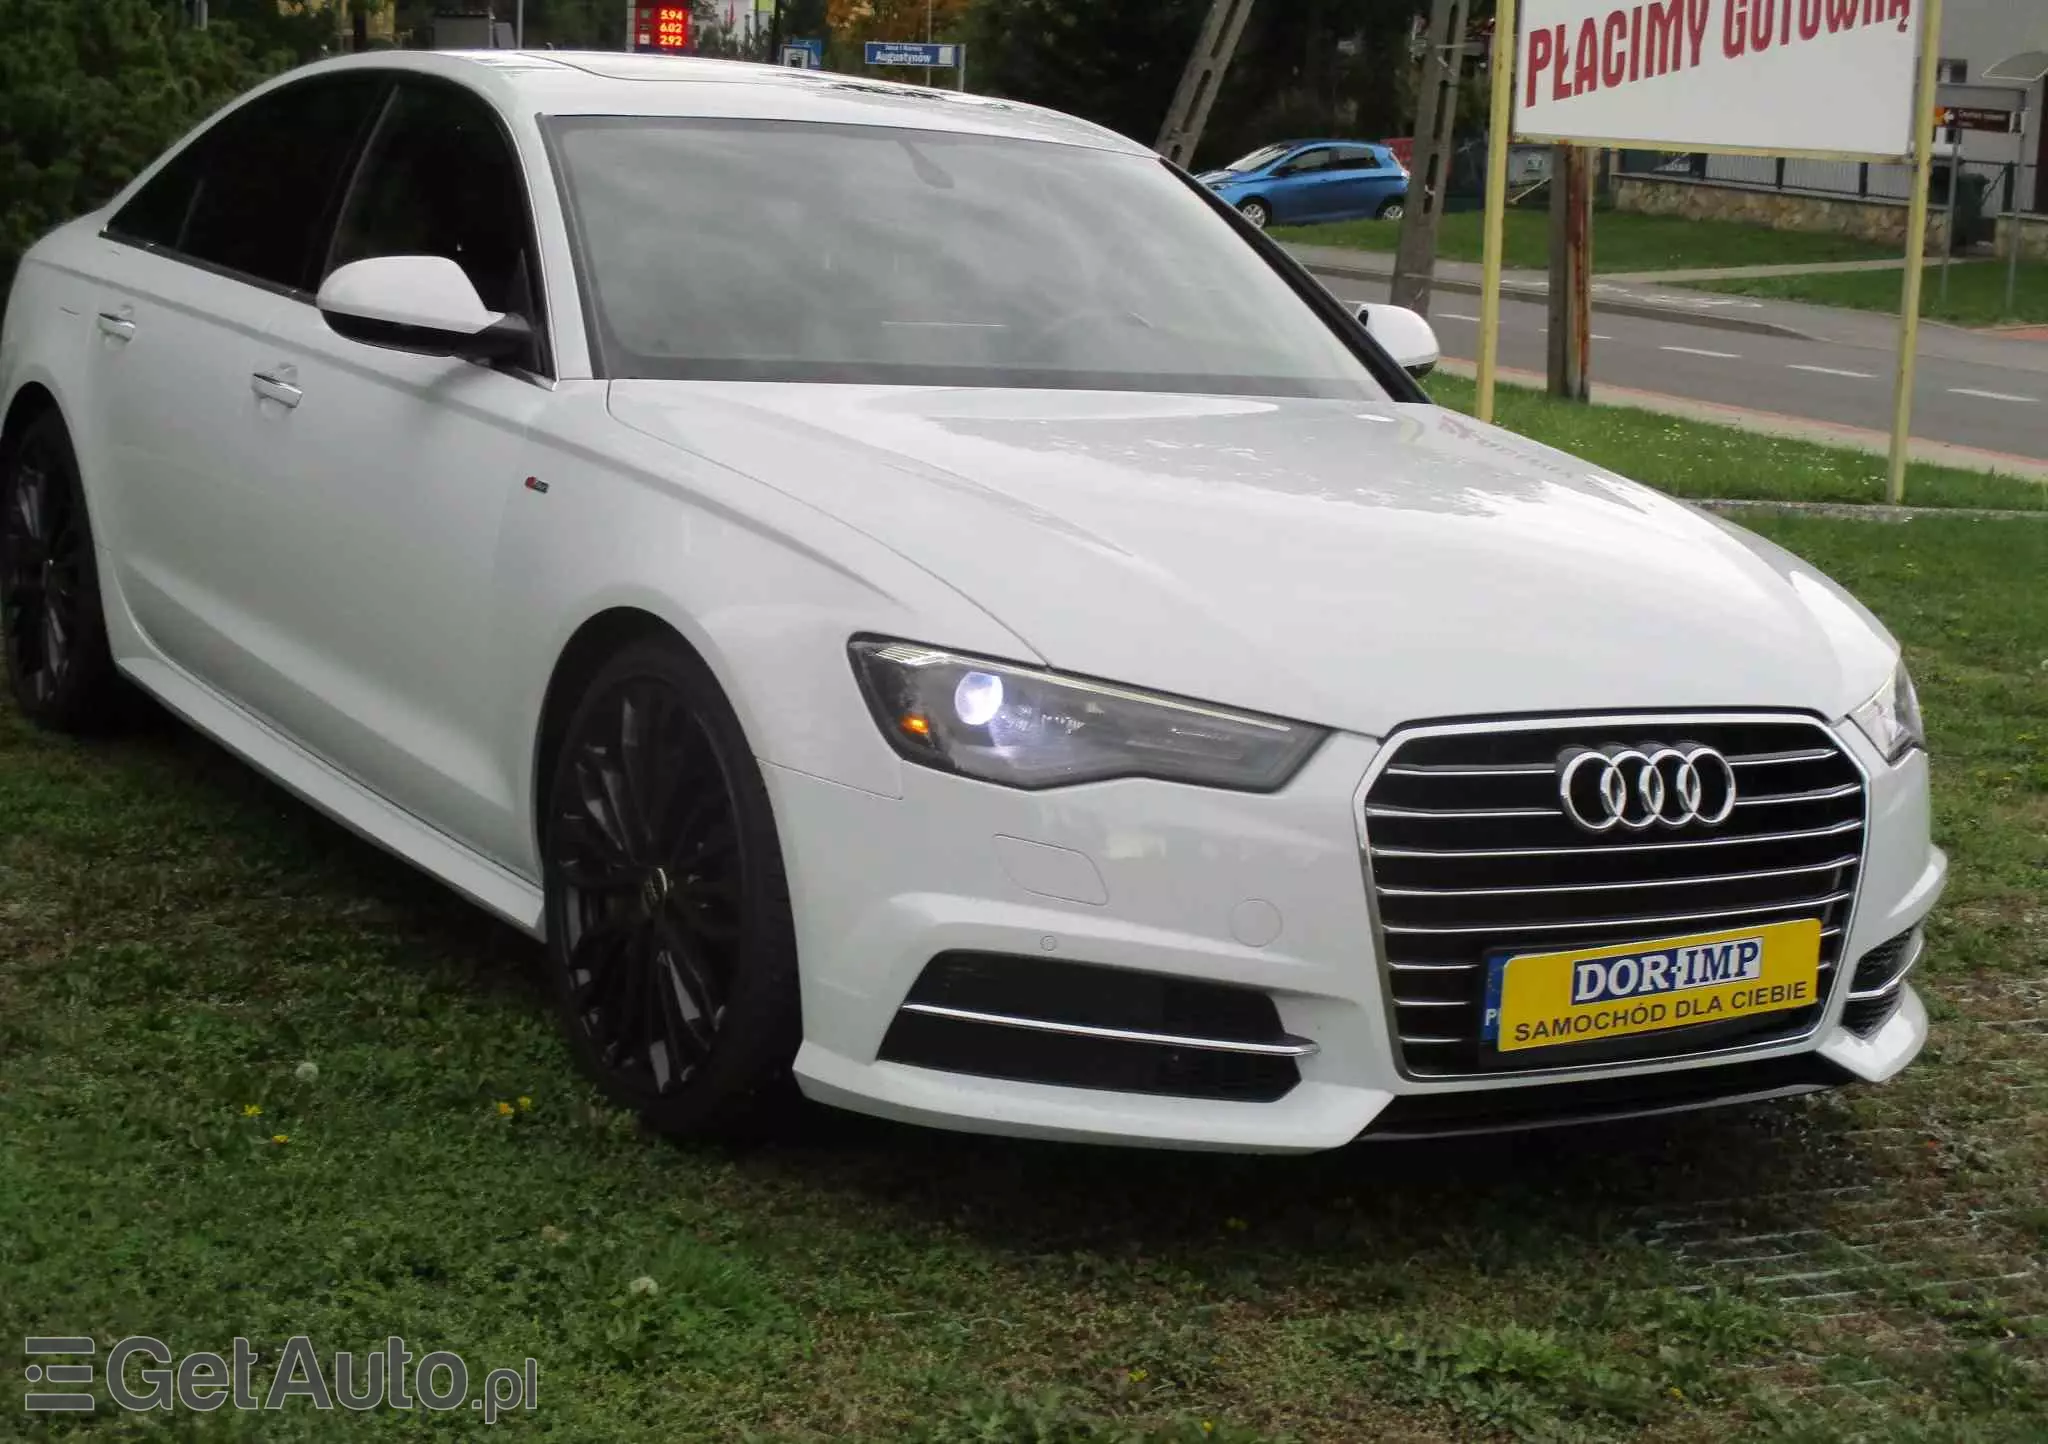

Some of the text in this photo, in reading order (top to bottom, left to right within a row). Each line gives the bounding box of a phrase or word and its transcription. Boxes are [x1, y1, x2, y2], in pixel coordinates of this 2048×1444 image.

[1526, 0, 1710, 108] PŁACIMY
[1514, 981, 1807, 1043] SAMOCHÓD DLA CIEBIE
